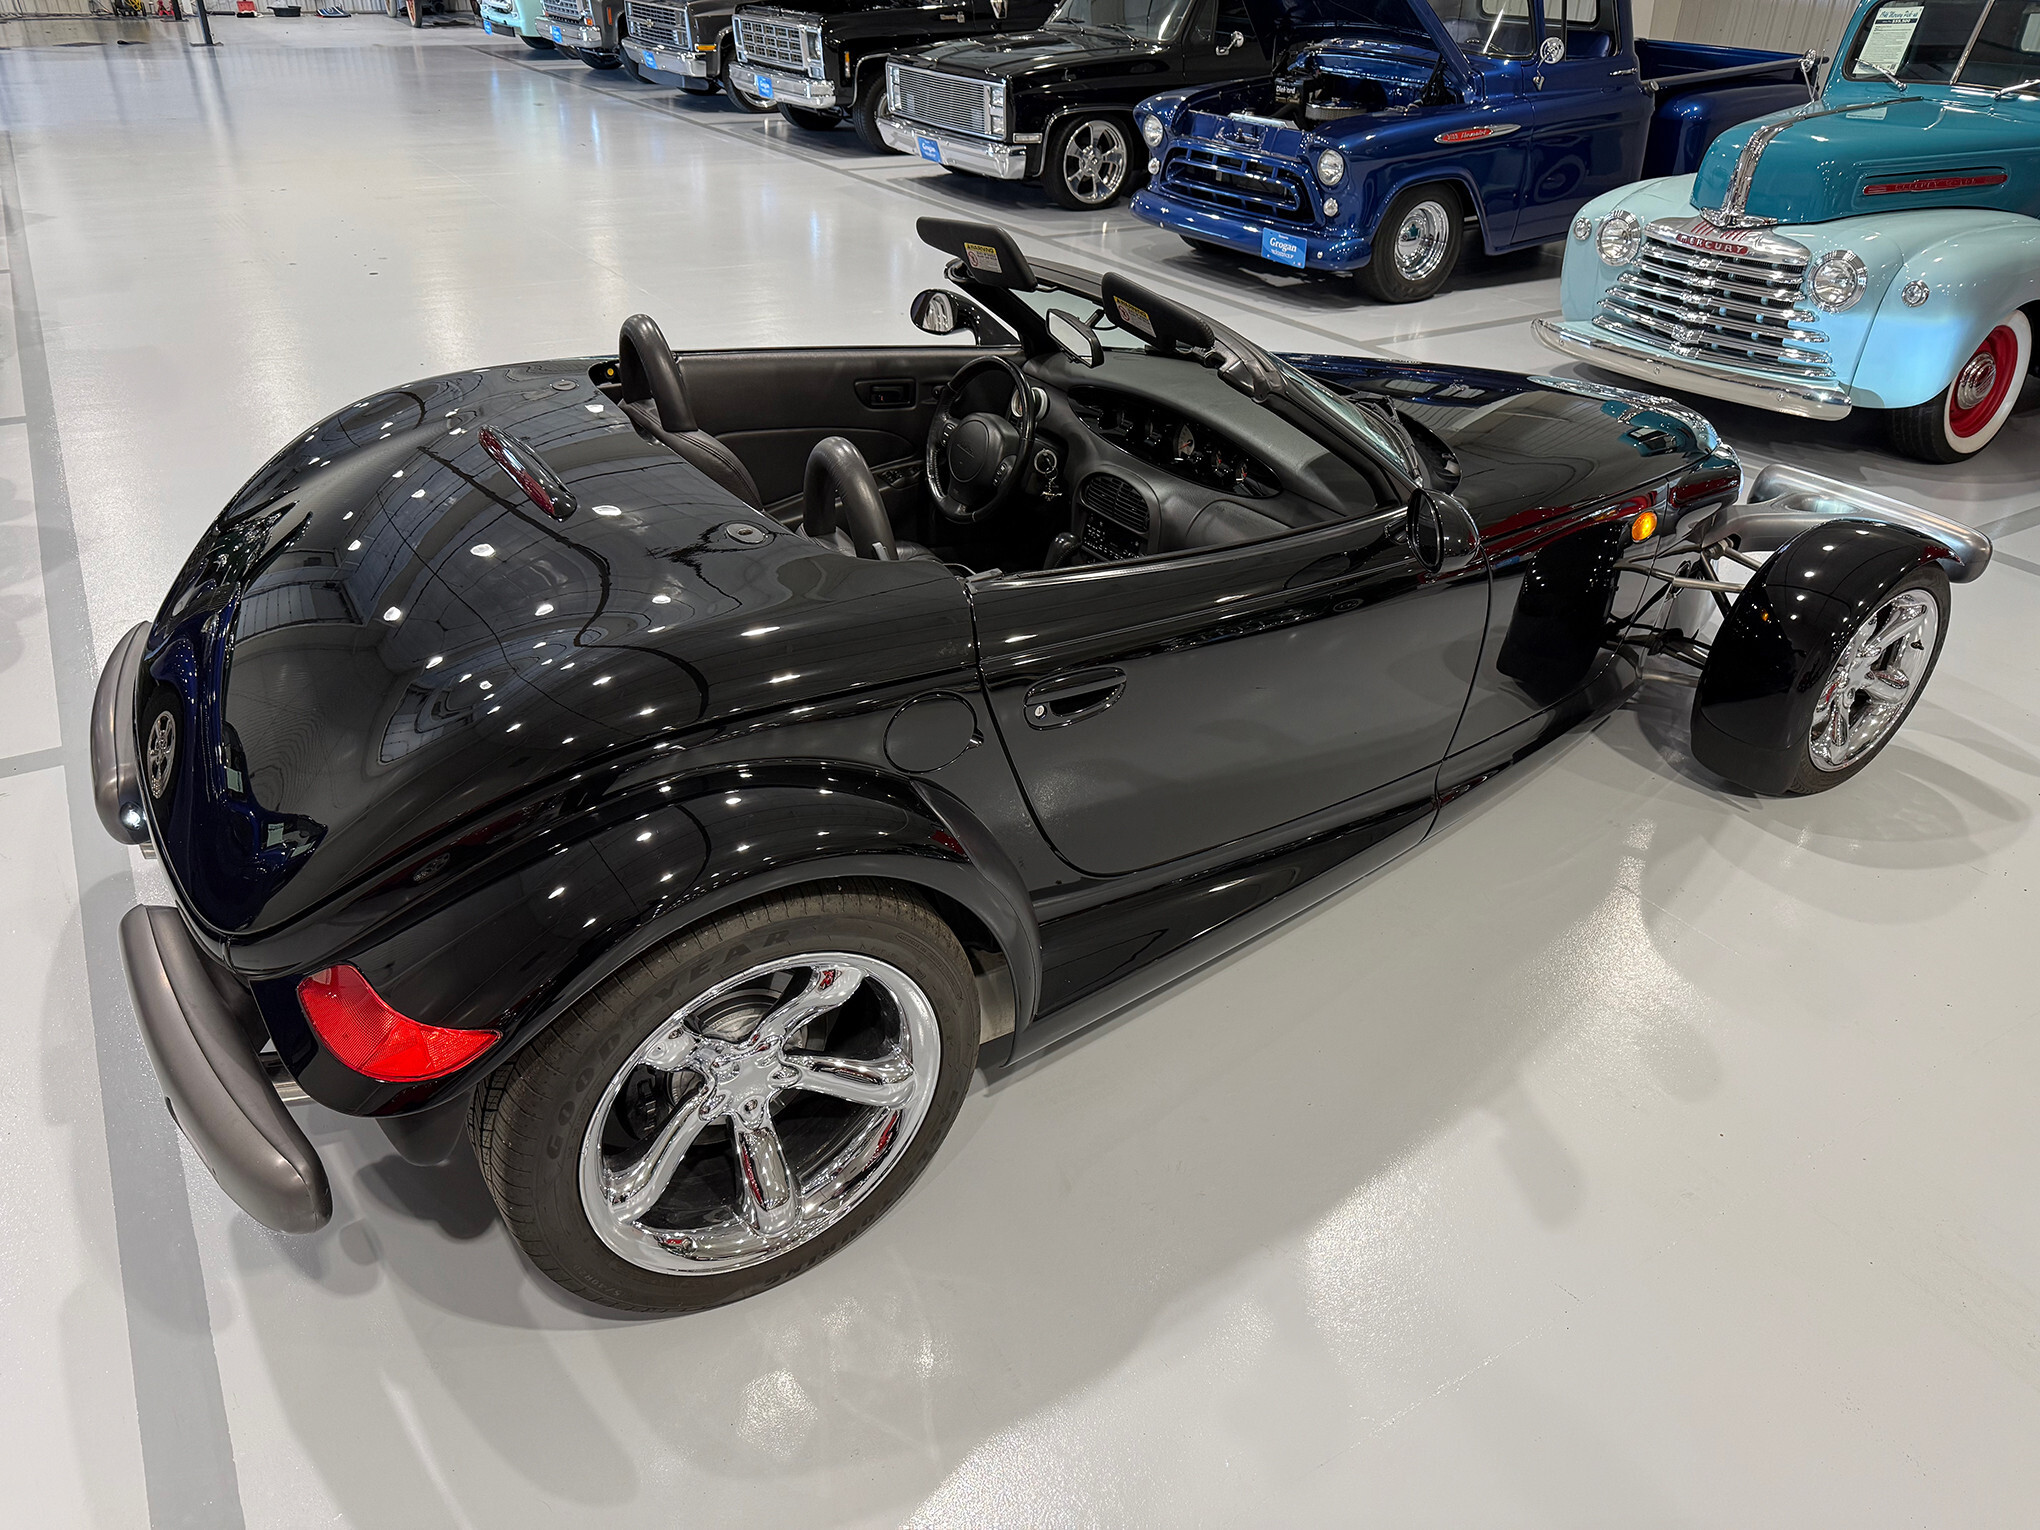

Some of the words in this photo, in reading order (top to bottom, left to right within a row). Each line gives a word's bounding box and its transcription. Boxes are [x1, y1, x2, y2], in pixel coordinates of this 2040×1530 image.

[1269, 237, 1298, 253] Grogan
[1680, 234, 1744, 254] MERCURY
[546, 928, 792, 1160] GOODYEAR
